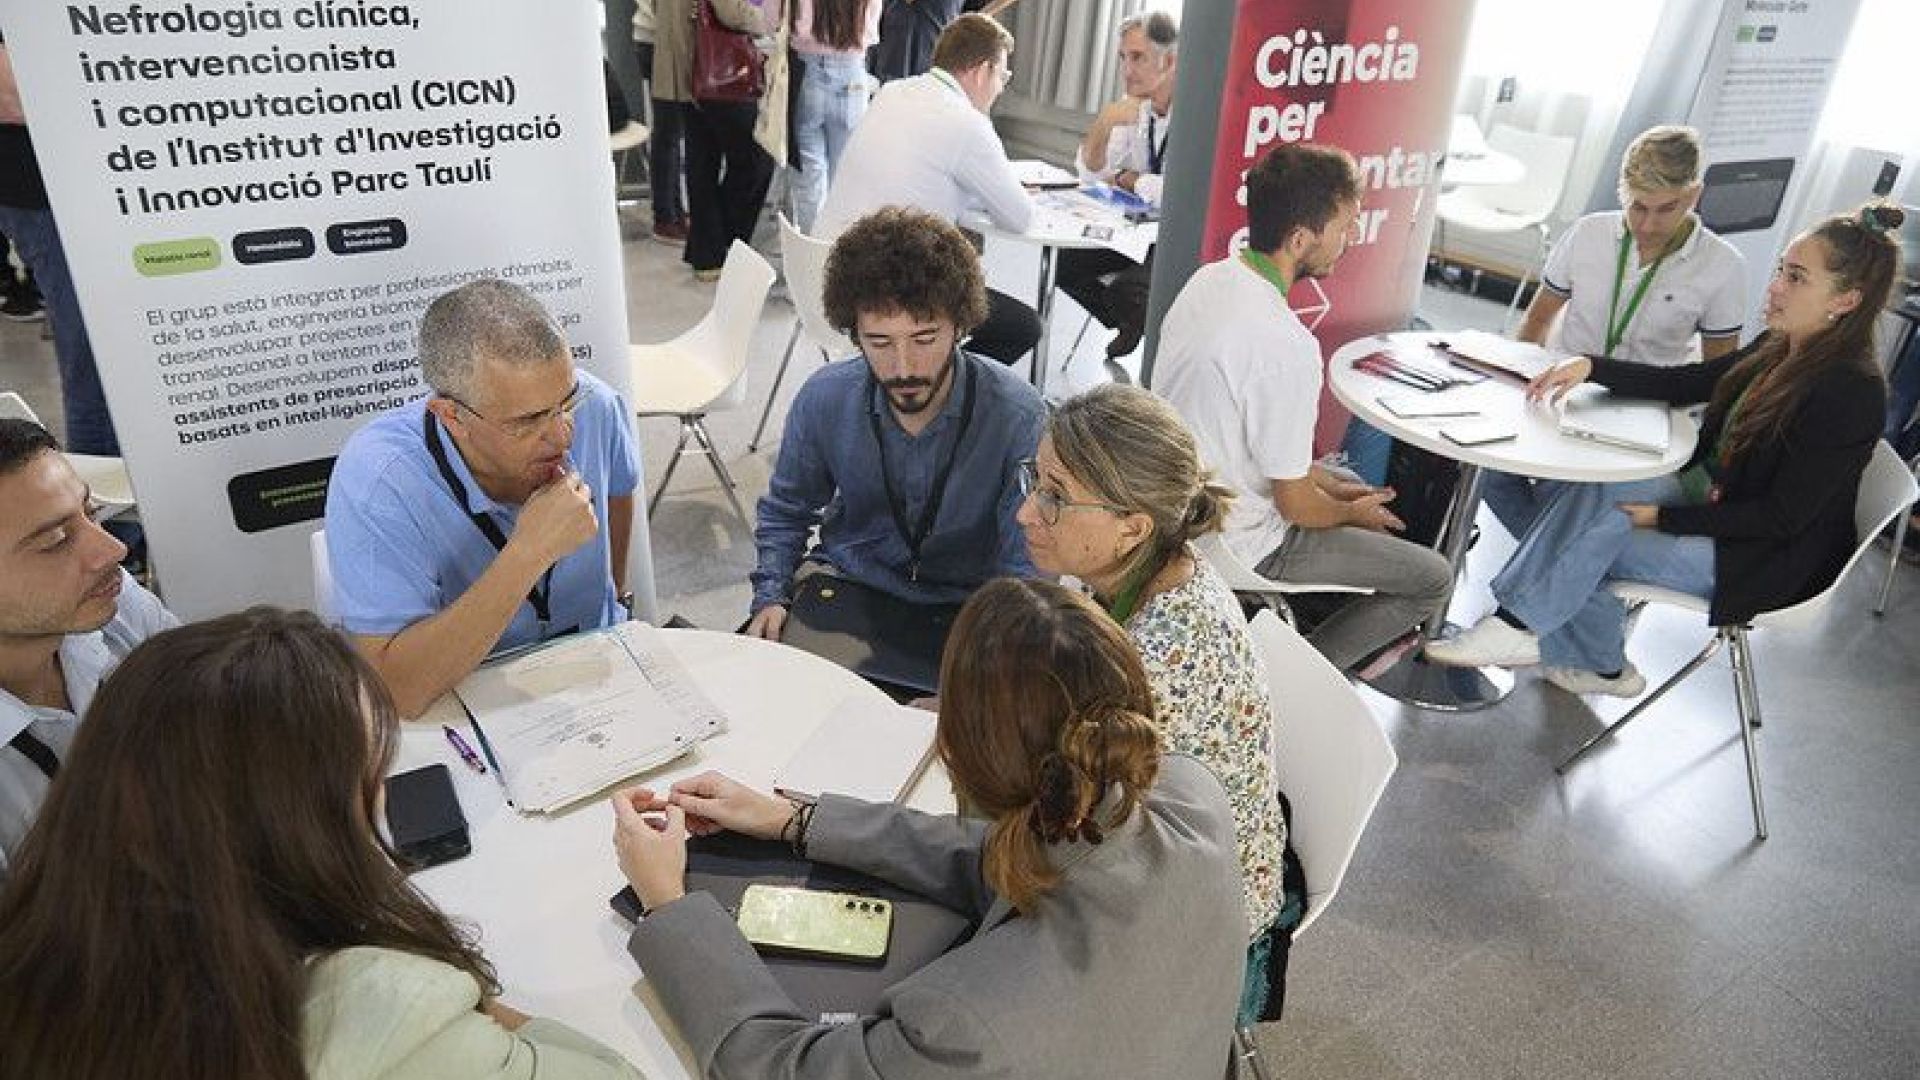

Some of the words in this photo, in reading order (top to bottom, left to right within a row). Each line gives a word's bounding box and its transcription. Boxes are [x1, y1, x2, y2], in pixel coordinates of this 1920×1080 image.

[67, 1, 284, 37] Nefrologia
[294, 0, 420, 30] clínica,
[79, 44, 396, 82] intervencionista
[1256, 26, 1419, 88] Ciència
[91, 98, 106, 128] i
[118, 85, 402, 127] computacional
[411, 75, 516, 110] (CICN)
[107, 144, 157, 172] de
[167, 132, 323, 168] l'Institut
[335, 113, 562, 155] d'Investigació
[1244, 101, 1326, 158] per
[115, 187, 129, 215] i
[137, 171, 323, 213] Innovació
[331, 170, 409, 196] Parc
[416, 156, 492, 187] Taulí
[146, 309, 164, 326] El
[170, 305, 217, 326] grup
[223, 296, 268, 315] està
[272, 286, 347, 307] integrat
[351, 283, 380, 301] per
[386, 267, 497, 296] professionals
[153, 328, 181, 346] de
[184, 327, 205, 342] la
[268, 305, 366, 331] enginyeria
[556, 276, 583, 293] per
[158, 338, 293, 367] desenvolupar
[299, 322, 385, 348] projectes
[389, 320, 412, 334] en
[163, 353, 292, 386] translacional
[295, 353, 308, 366] a
[384, 335, 407, 352] de
[174, 396, 280, 426] assistents
[284, 391, 308, 407] de
[314, 374, 419, 404] prescripció
[226, 364, 369, 397] Desenvolupem
[178, 420, 251, 444] basats
[256, 416, 282, 432] en
